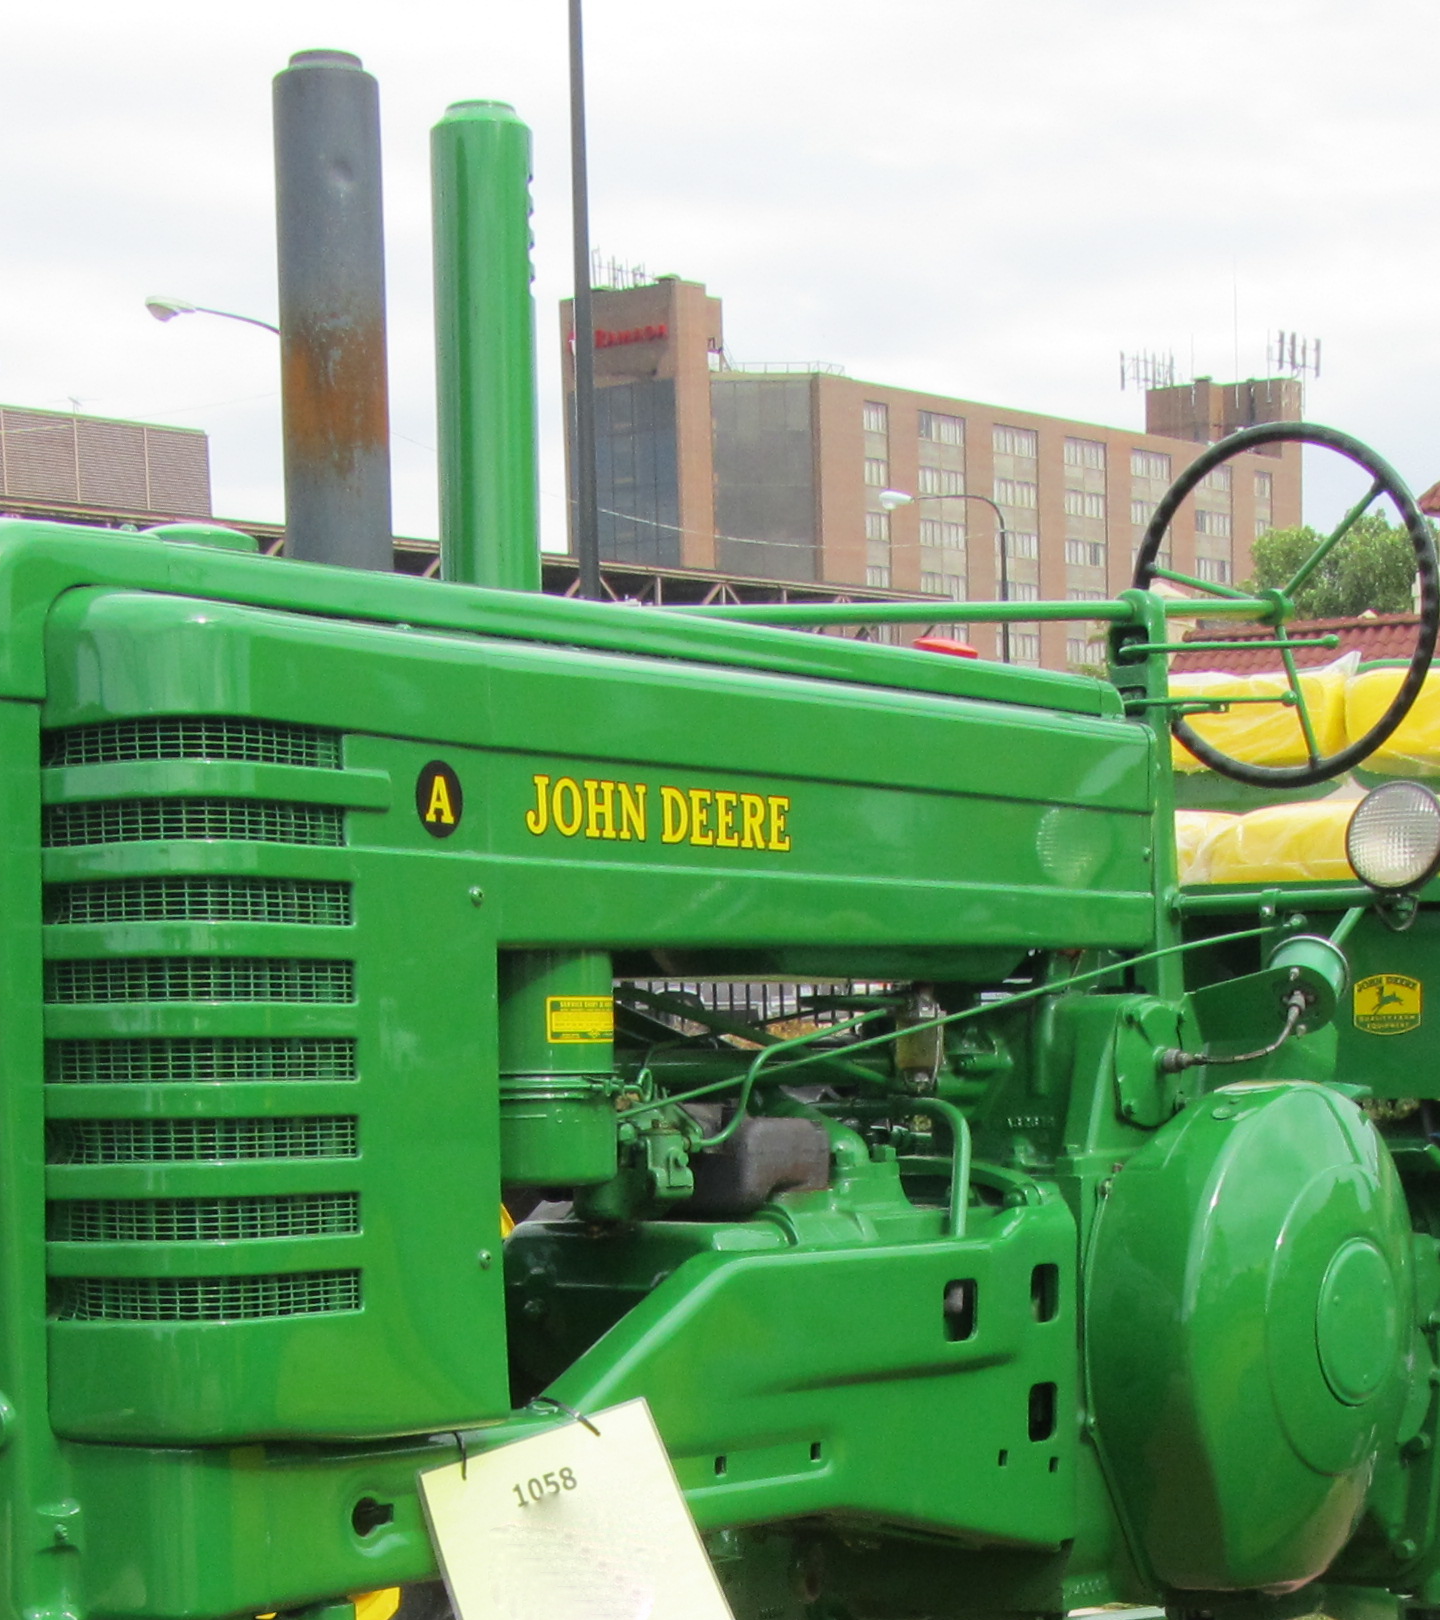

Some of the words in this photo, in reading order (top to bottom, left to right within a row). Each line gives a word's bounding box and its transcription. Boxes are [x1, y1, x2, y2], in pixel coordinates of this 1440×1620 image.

[594, 324, 669, 349] RAMADA
[425, 775, 455, 825] A
[525, 773, 647, 842] JOHN
[660, 785, 791, 852] DEERE
[512, 1466, 578, 1508] 1058
